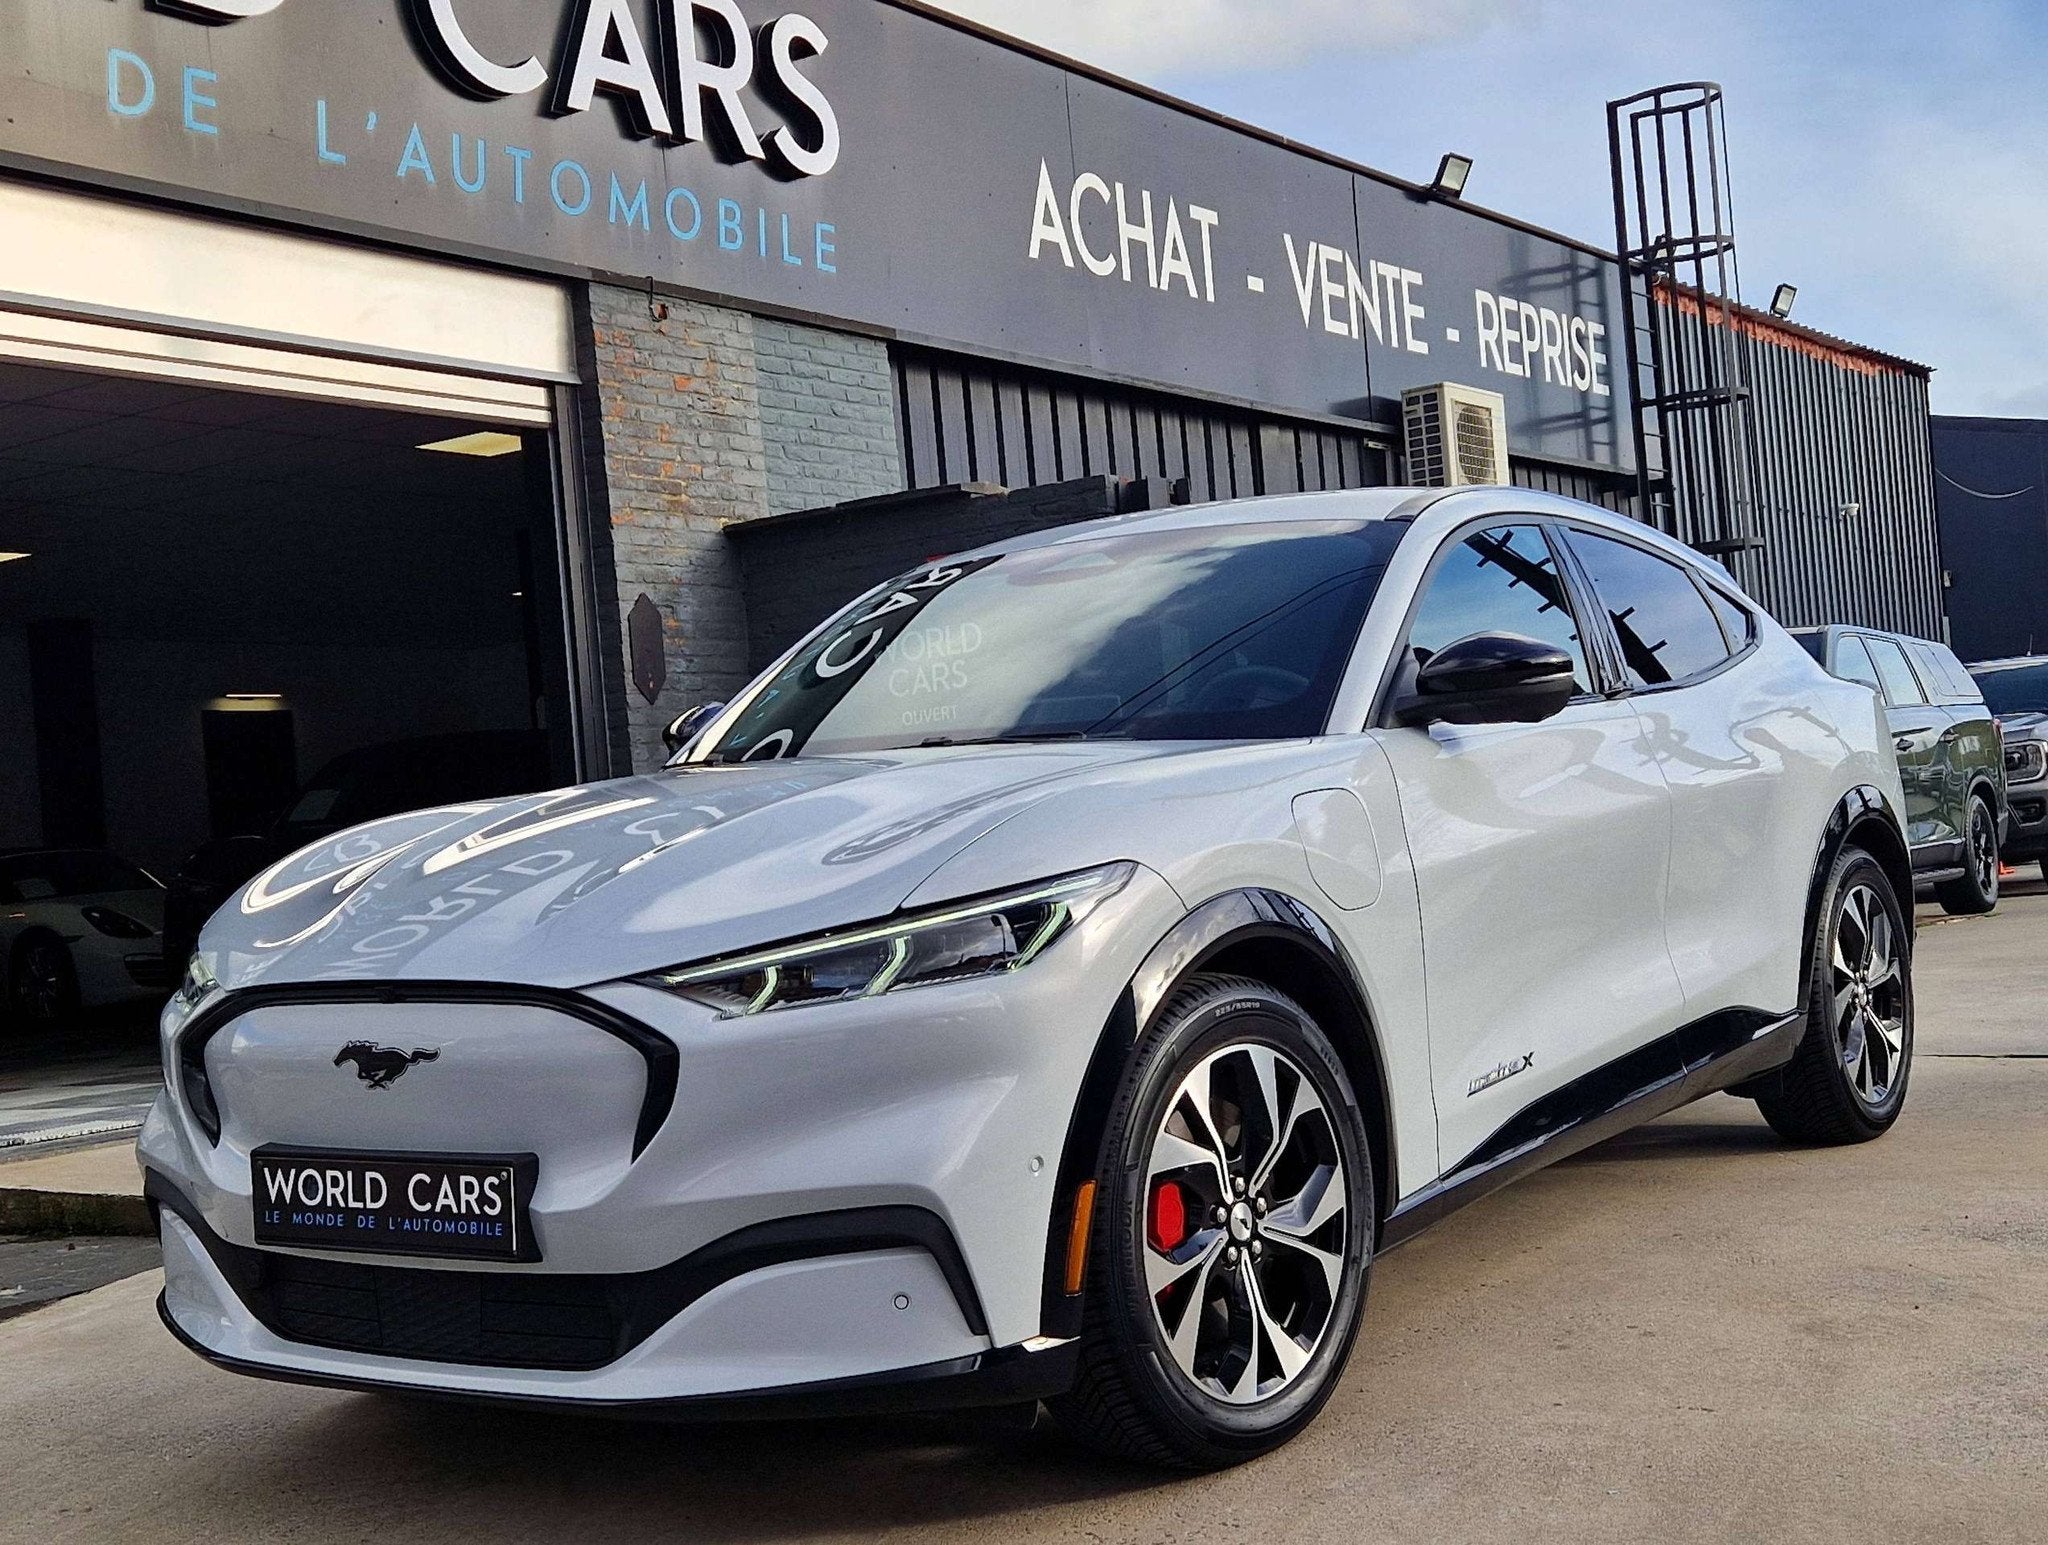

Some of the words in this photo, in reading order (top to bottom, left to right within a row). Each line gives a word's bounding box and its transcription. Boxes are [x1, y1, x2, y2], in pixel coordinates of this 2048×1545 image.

[107, 48, 218, 135] DE
[316, 98, 839, 275] L'AUTOMOBILE
[1028, 156, 1219, 303] ACHAT
[1283, 233, 1430, 355] VENTE
[1474, 289, 1611, 396] REPRISE
[889, 659, 968, 697] CARS
[902, 704, 958, 725] OUVERT
[262, 1167, 388, 1210] WORLD
[407, 1172, 502, 1216] CARS
[265, 1210, 281, 1224] LE
[292, 1212, 345, 1227] MONDE
[357, 1215, 376, 1229] DE
[388, 1217, 504, 1236] L'AUTOMOBILE
